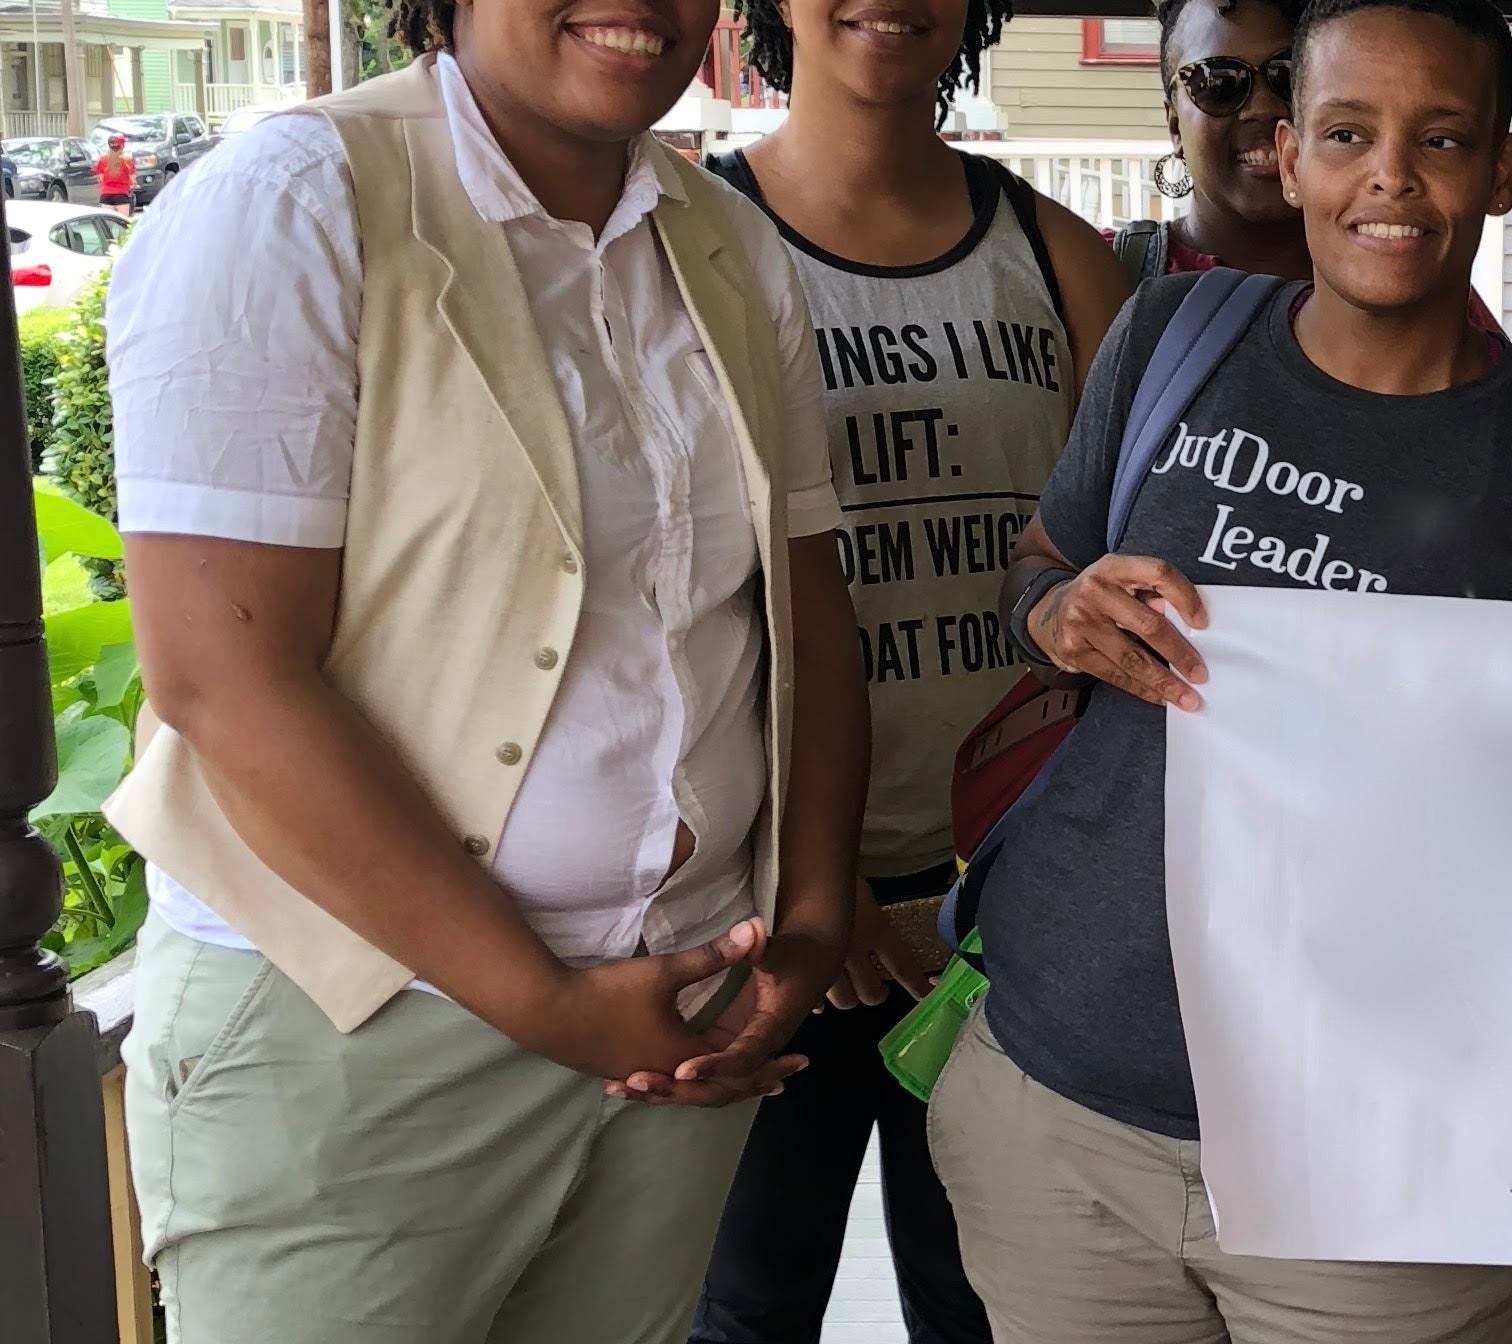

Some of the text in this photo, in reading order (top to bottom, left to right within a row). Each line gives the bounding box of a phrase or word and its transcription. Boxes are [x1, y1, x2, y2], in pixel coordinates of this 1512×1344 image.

[815, 320, 1060, 392] INGS I LIKE
[846, 408, 962, 485] LIFT:
[923, 513, 1032, 577] WEIG
[1198, 504, 1388, 594] Leader
